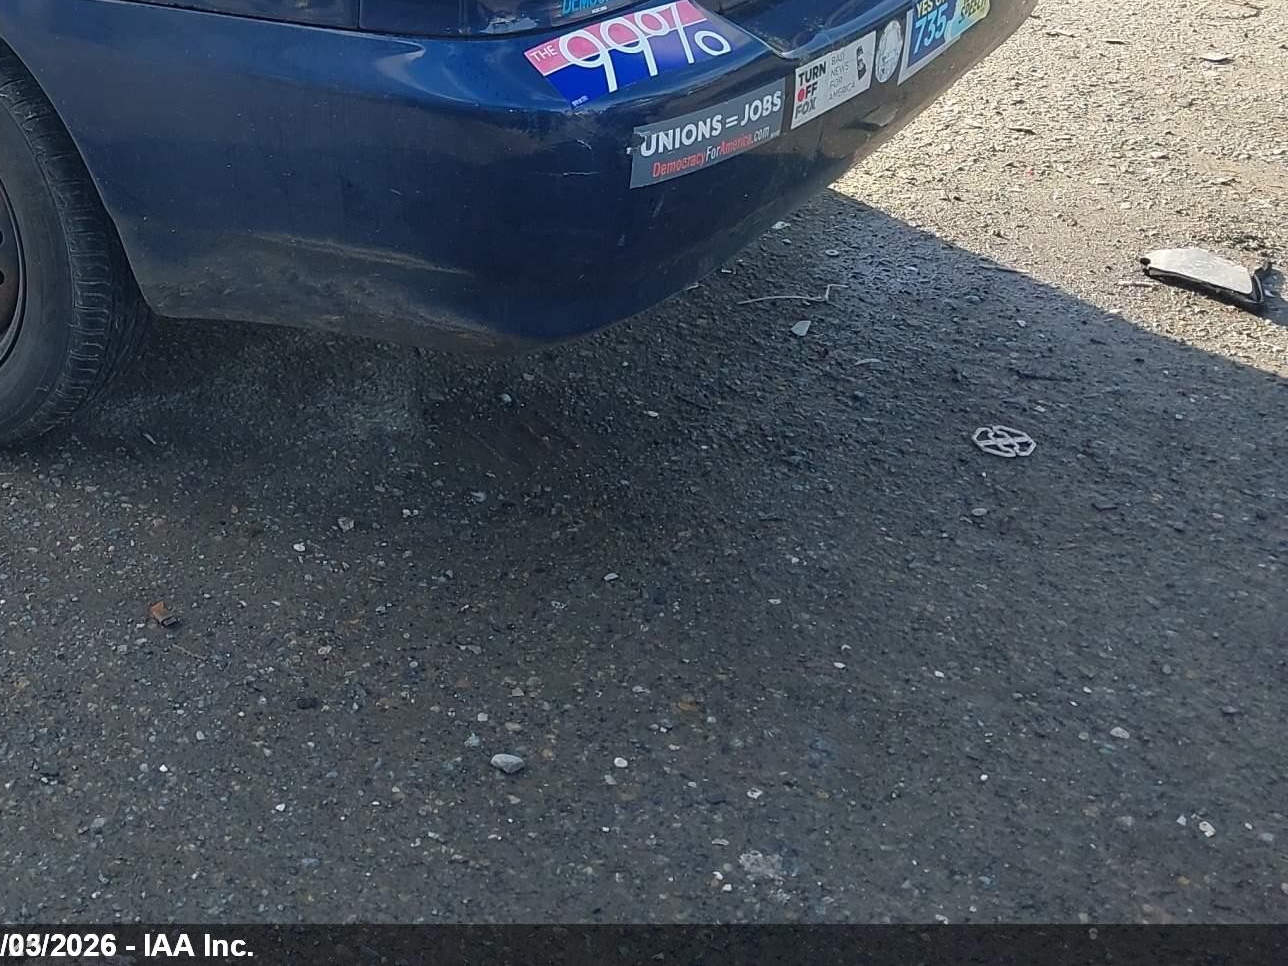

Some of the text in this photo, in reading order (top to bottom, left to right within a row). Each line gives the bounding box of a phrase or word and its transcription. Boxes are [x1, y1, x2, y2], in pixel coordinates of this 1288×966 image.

[913, 3, 949, 55] 735
[531, 2, 732, 93] THE 99%
[831, 52, 845, 66] BAD
[831, 61, 850, 78] NEWS
[798, 61, 827, 87] TURN
[830, 76, 843, 91] FOR
[797, 81, 818, 103] OFF
[829, 81, 856, 101] AMERICA
[795, 97, 817, 119] FOX
[640, 114, 723, 157] UNIONS
[740, 90, 783, 127] JOBS
[652, 125, 771, 179] DemocracyForAmerica.com
